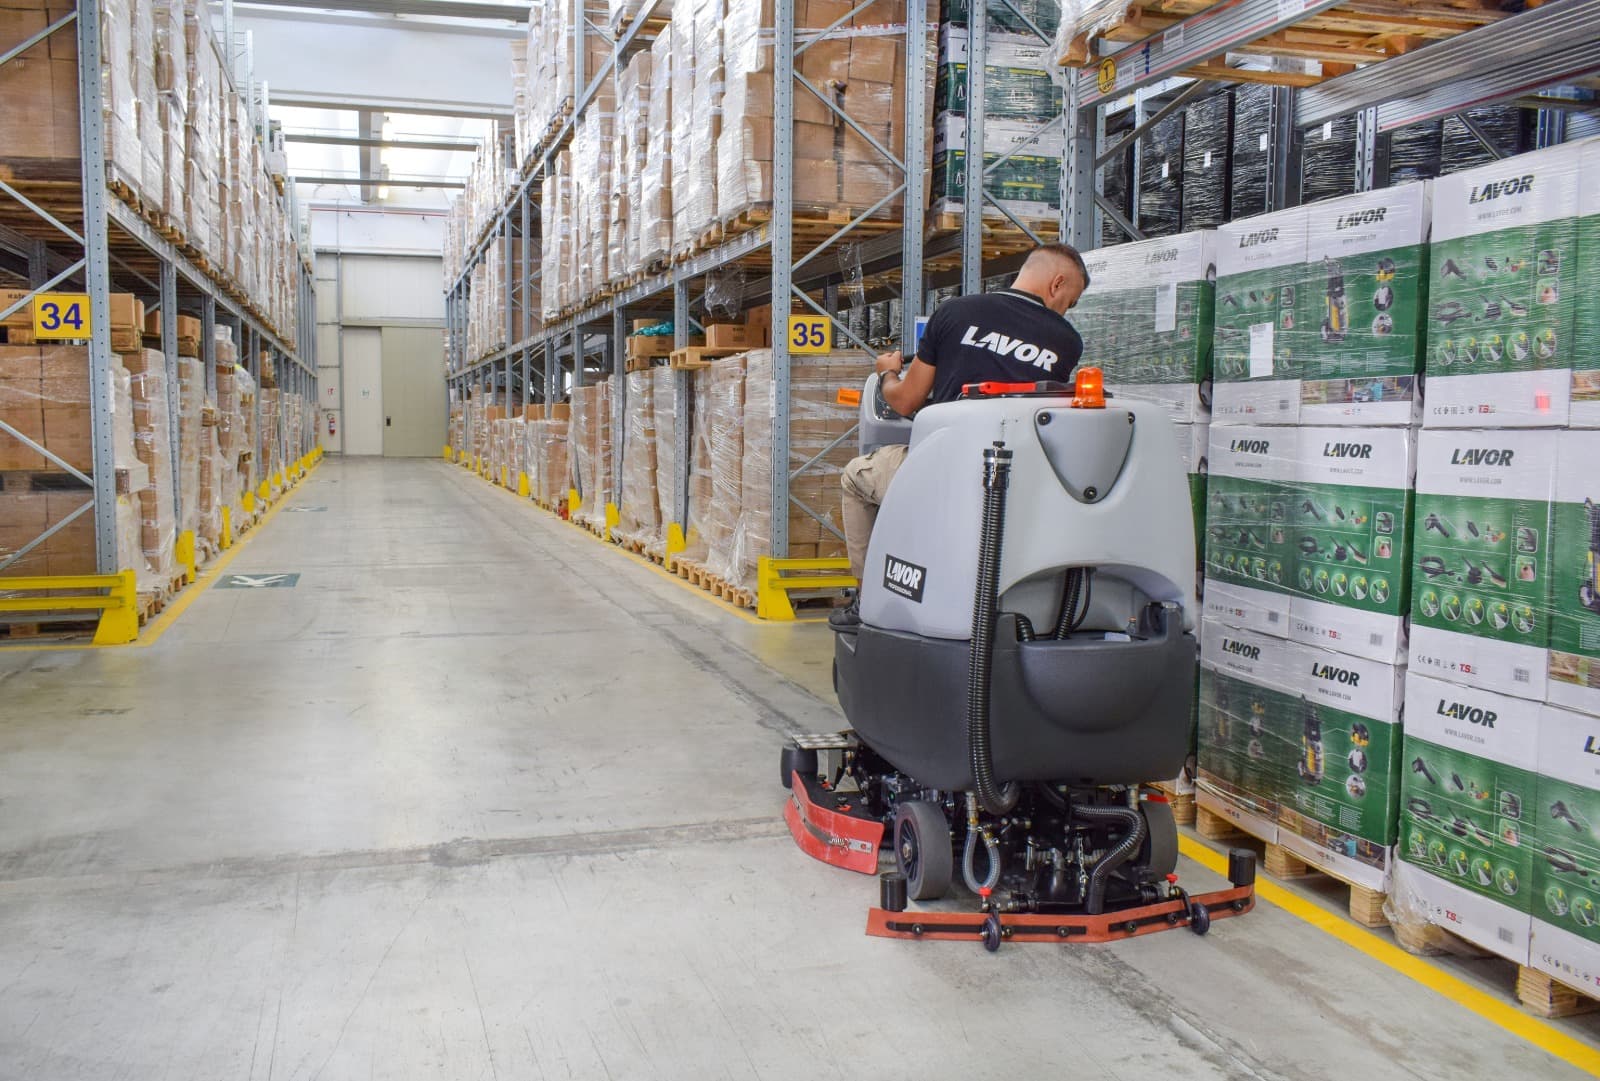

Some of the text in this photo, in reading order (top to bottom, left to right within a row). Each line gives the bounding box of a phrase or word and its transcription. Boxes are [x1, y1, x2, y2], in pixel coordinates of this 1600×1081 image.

[1469, 174, 1534, 204] LAVOR
[1336, 207, 1387, 230] LAVOR
[1239, 228, 1279, 248] LAVOR
[1144, 248, 1178, 265] LAVOR
[41, 302, 83, 330] 34
[792, 322, 824, 347] 35
[960, 326, 1058, 372] LAVOR
[1230, 440, 1270, 454] LAVOR
[1324, 442, 1372, 458] LAVOR
[1451, 448, 1514, 466] LAVOR
[886, 560, 922, 590] LAVOR
[1222, 638, 1260, 660] LAVOR
[1312, 662, 1360, 686] LAVOR
[1436, 699, 1497, 728] LAVOR
[1584, 899, 1592, 909] 2
